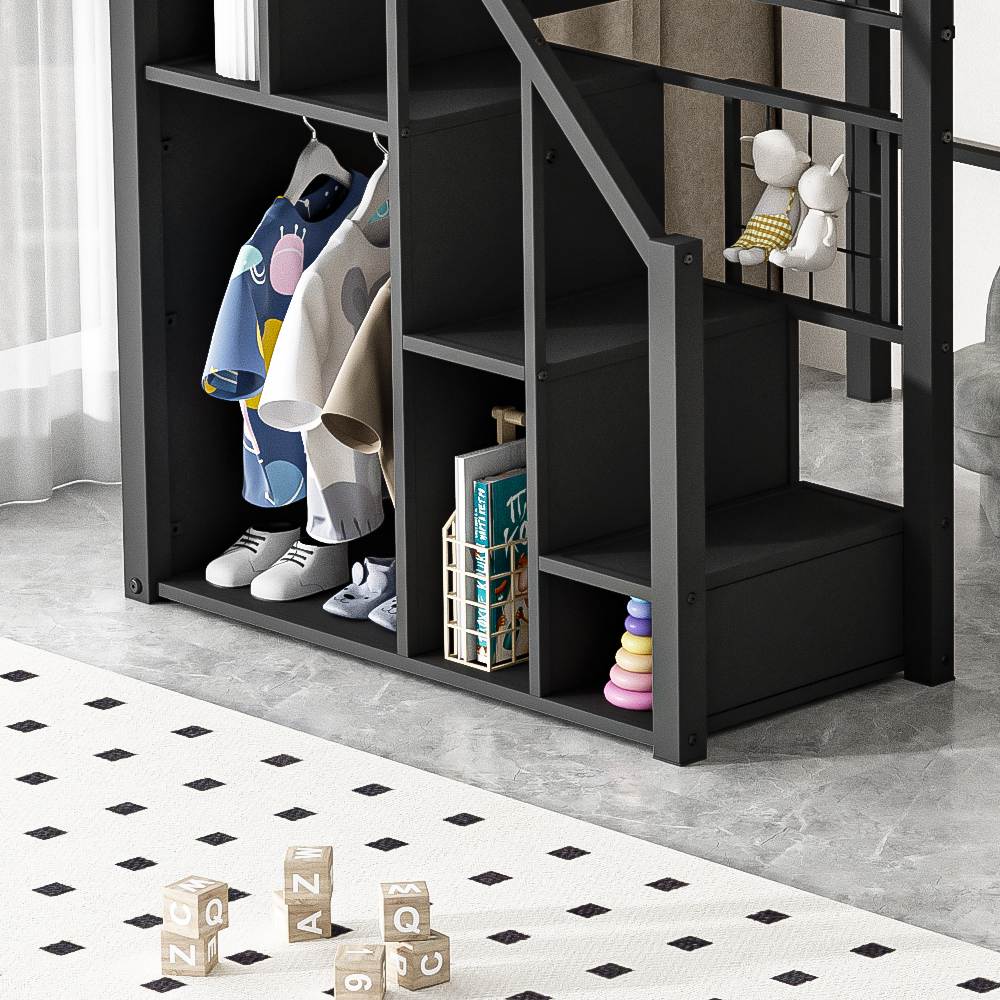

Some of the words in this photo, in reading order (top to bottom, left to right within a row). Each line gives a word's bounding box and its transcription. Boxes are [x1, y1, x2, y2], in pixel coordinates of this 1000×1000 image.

[205, 898, 223, 926] Q
[297, 910, 323, 935] A
[393, 906, 421, 934] Q
